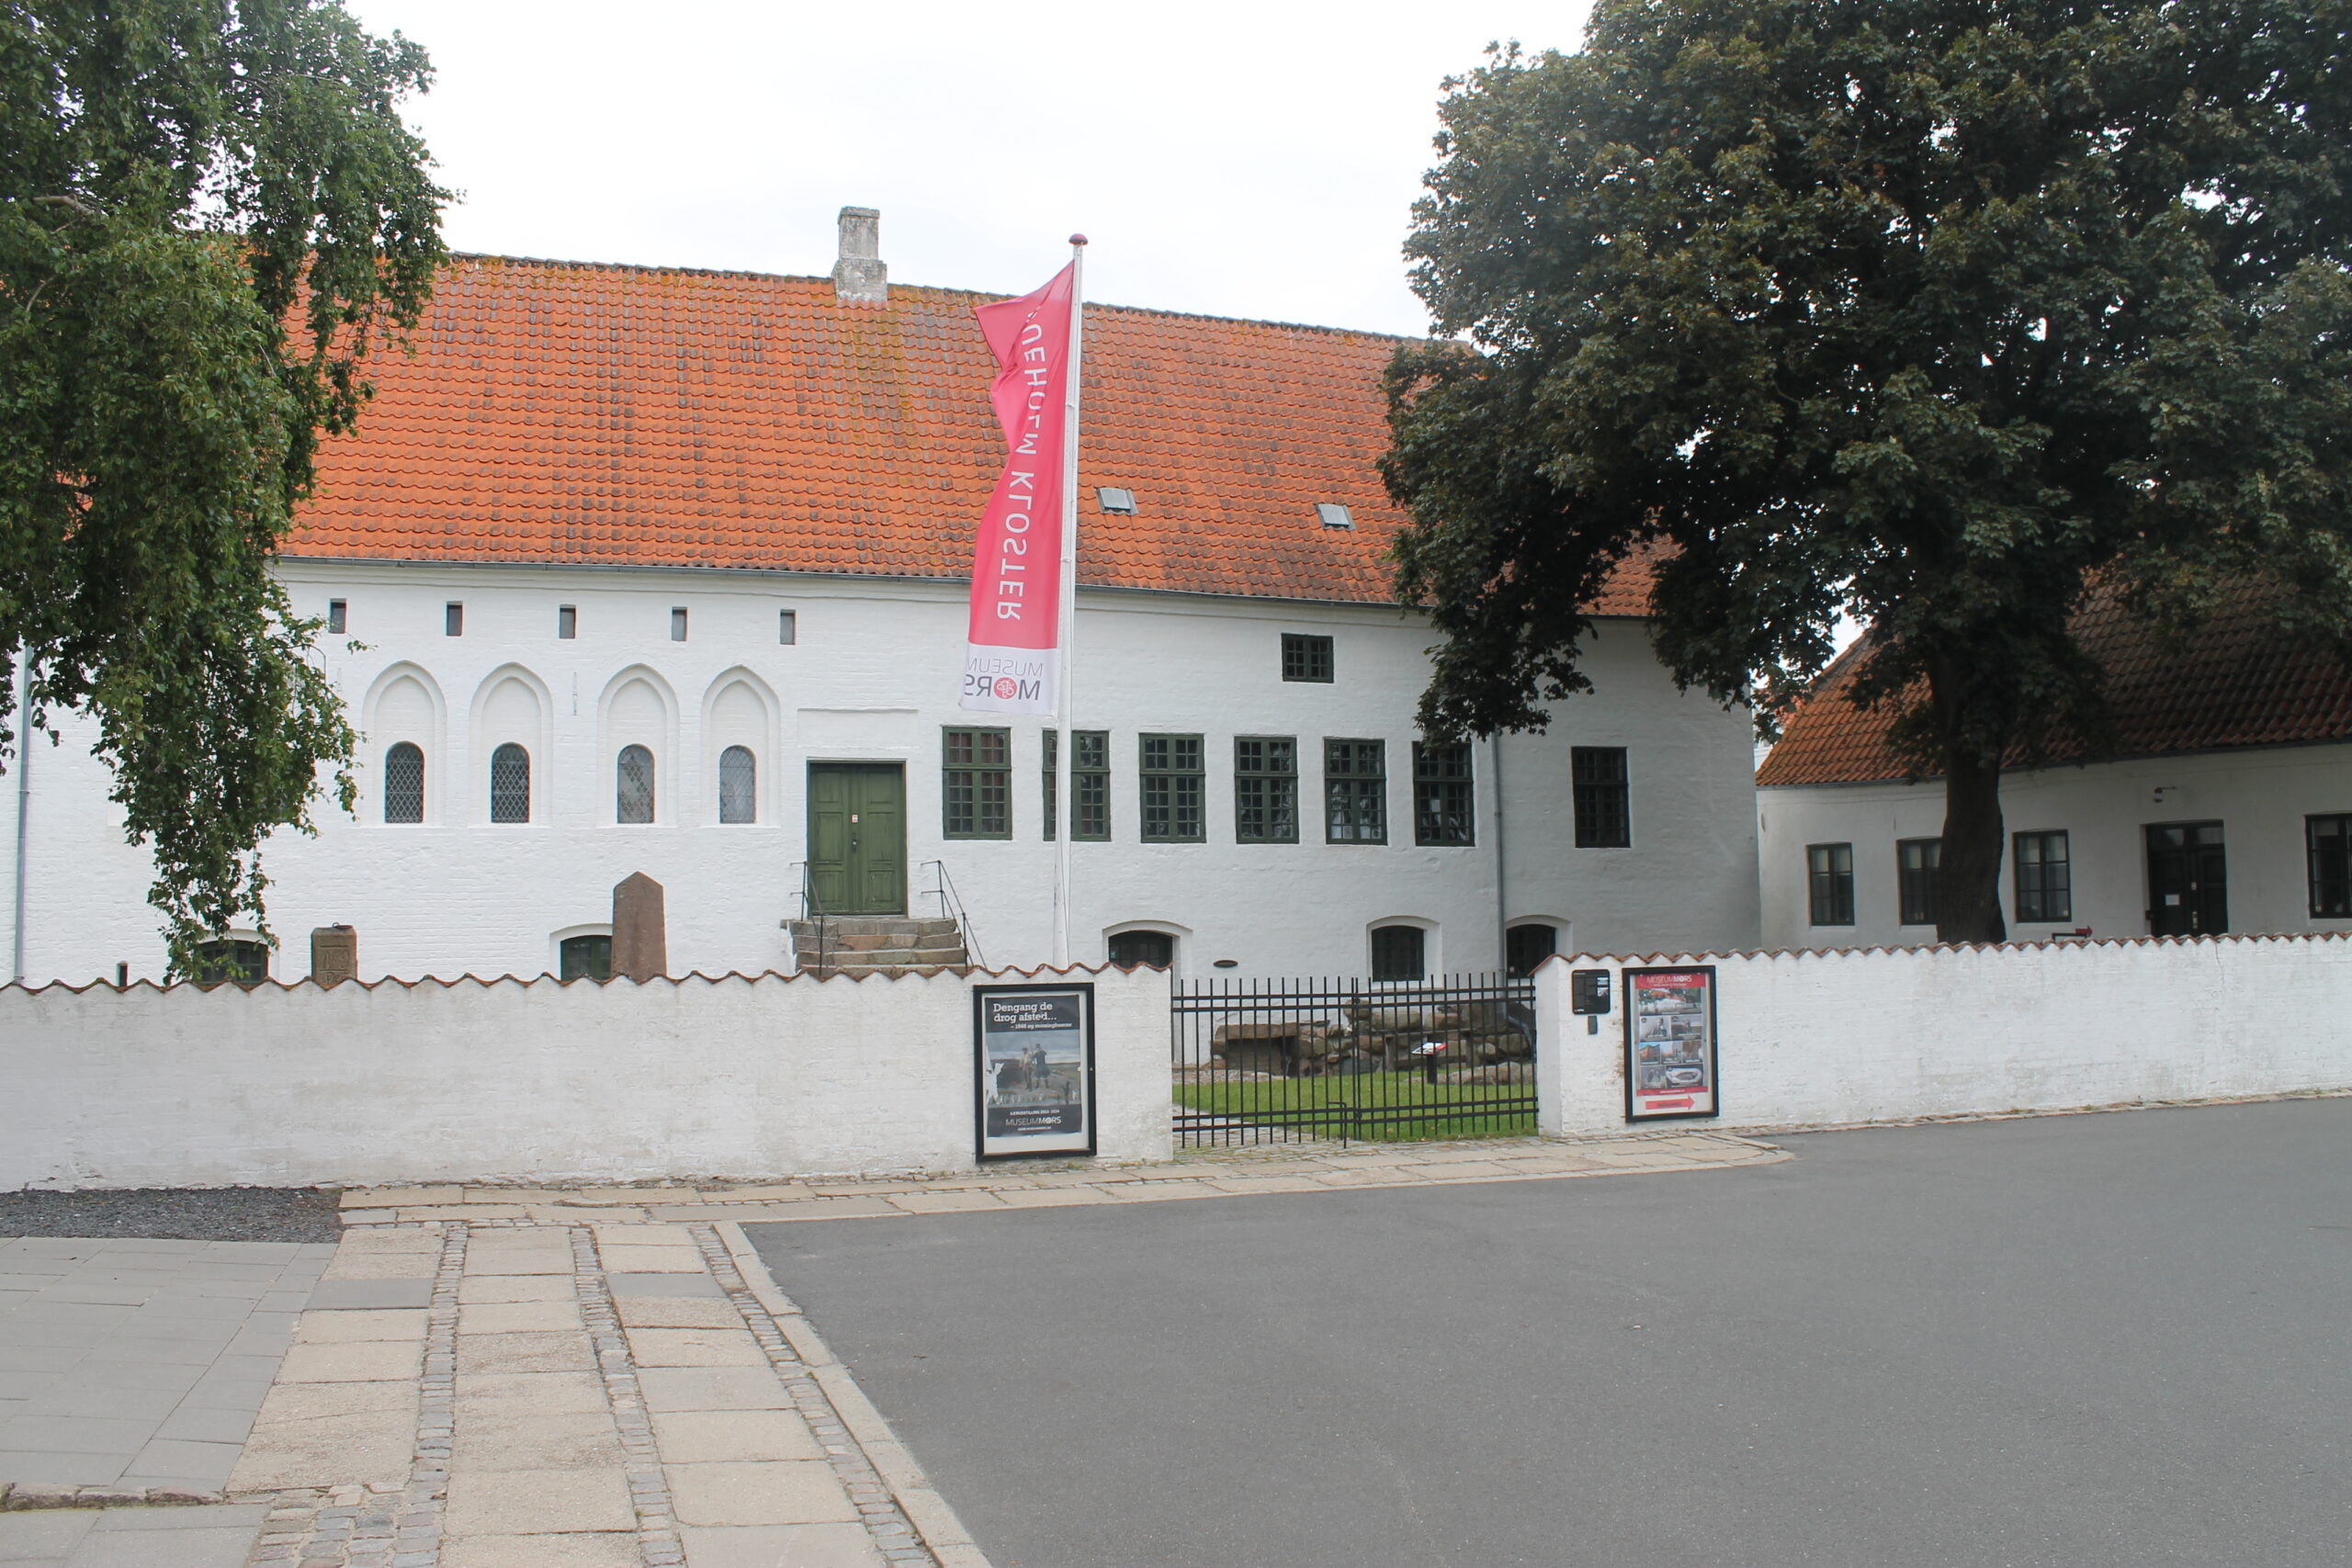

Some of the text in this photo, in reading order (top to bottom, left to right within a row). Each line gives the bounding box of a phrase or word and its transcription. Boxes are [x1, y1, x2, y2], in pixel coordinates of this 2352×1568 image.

[993, 1001, 1053, 1013] Dengang de
[993, 1013, 1017, 1024] drog
